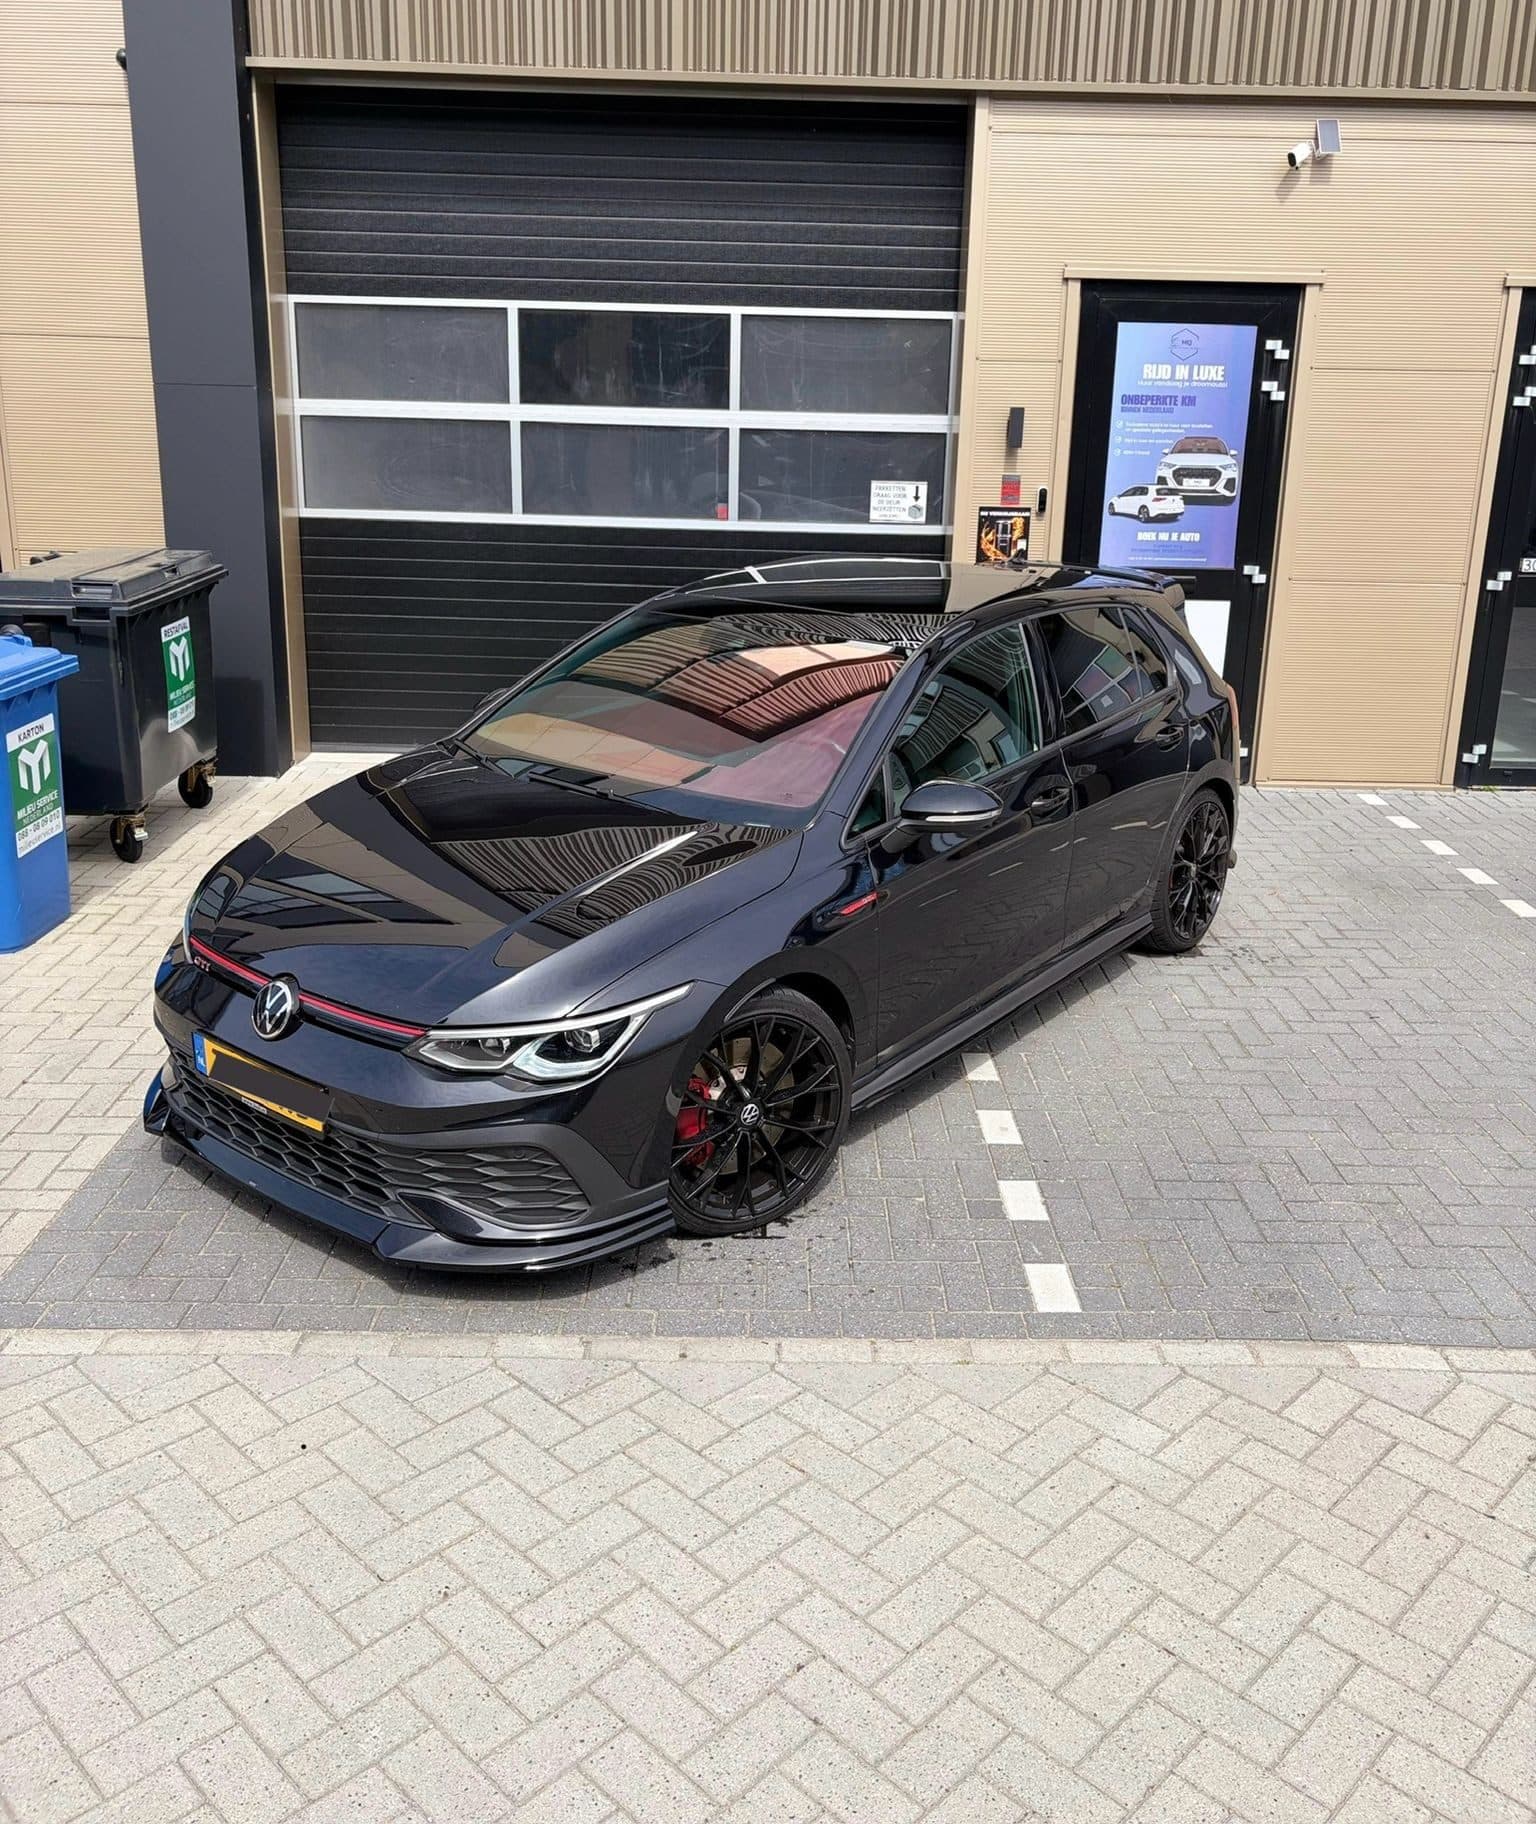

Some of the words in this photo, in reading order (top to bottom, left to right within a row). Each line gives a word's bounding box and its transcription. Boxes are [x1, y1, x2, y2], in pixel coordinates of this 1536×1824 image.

[1143, 363, 1171, 380] RIJD
[1175, 364, 1189, 380] IN
[1193, 364, 1225, 381] LUXE
[1121, 394, 1178, 406] ONBEPERKTE
[1181, 395, 1196, 407] KM
[1137, 531, 1157, 541] BOEK
[1179, 532, 1200, 542] AUTO
[17, 722, 44, 742] KARTON
[37, 790, 58, 809] SERVICE
[22, 802, 54, 824] NEDERLAND
[194, 956, 211, 972] GTI
